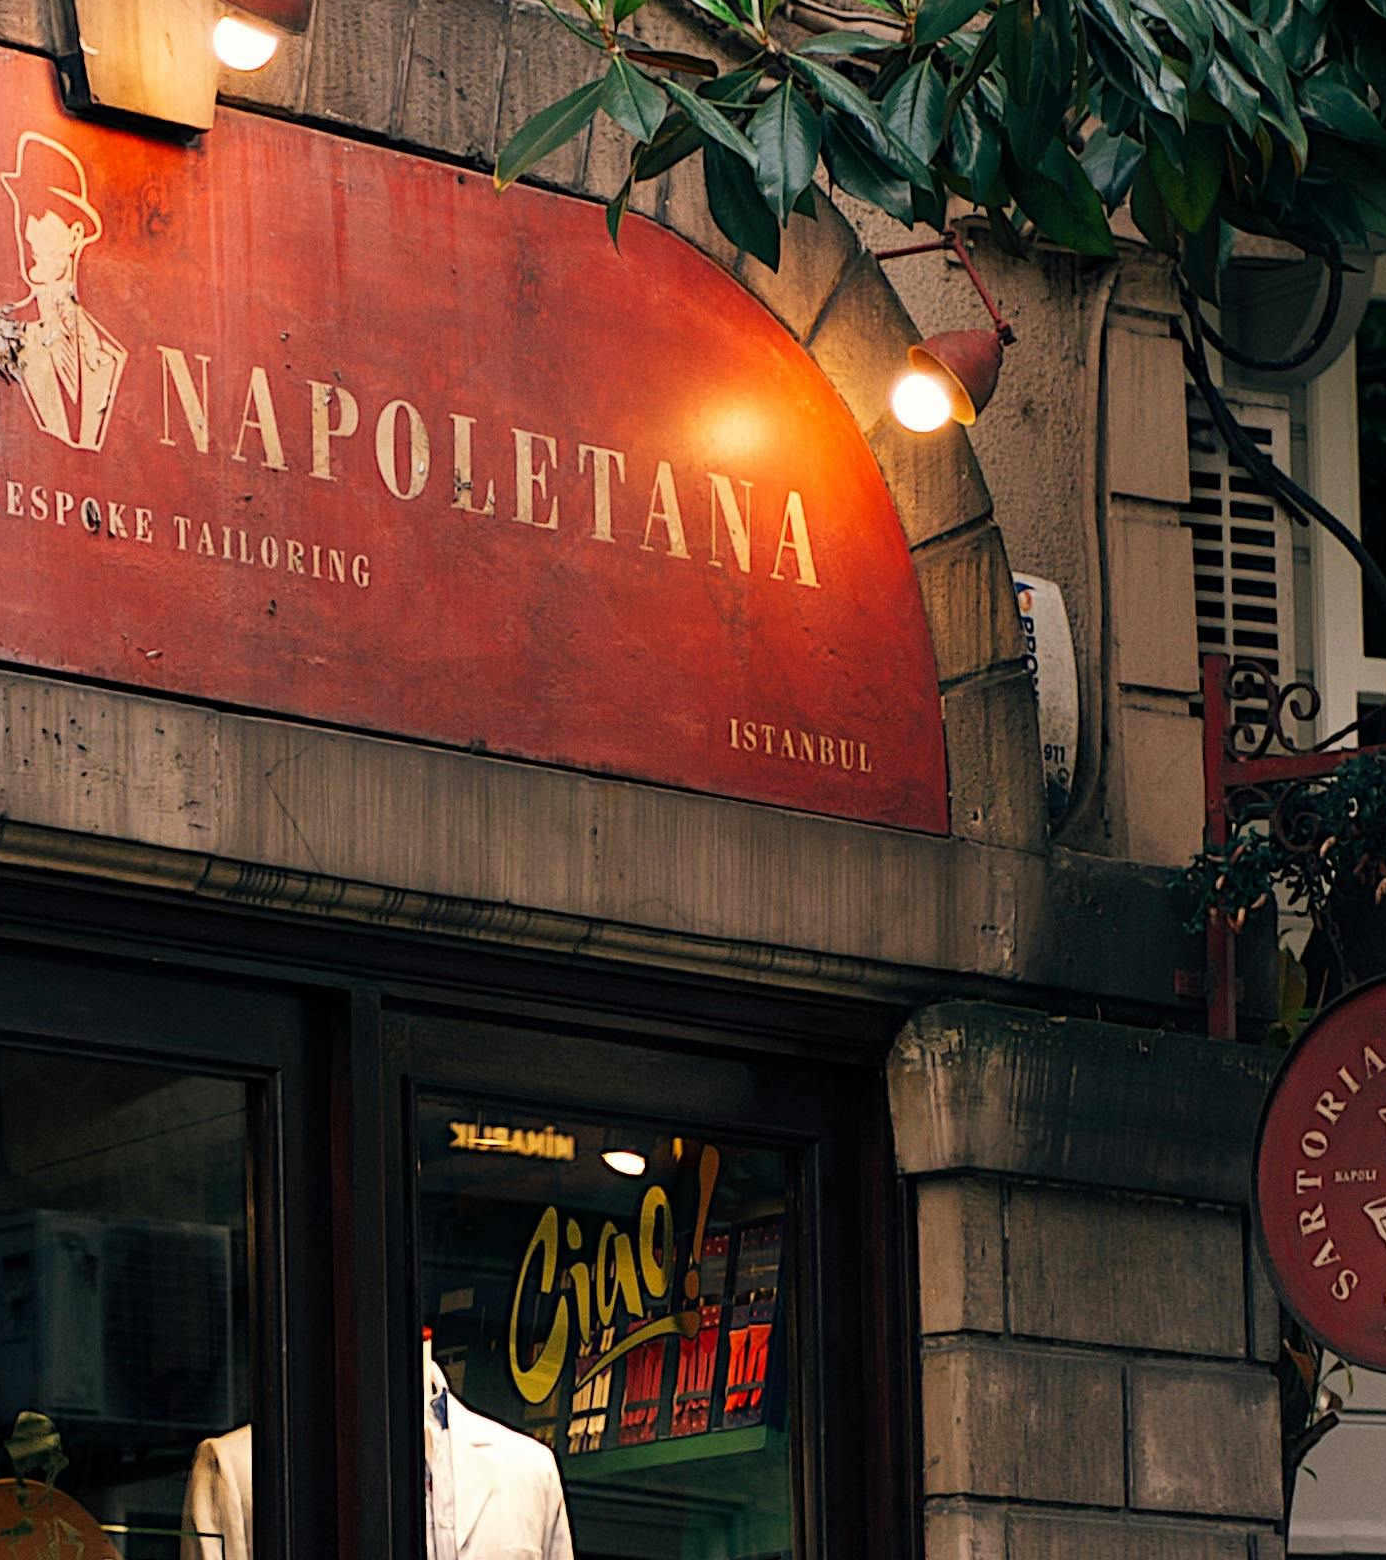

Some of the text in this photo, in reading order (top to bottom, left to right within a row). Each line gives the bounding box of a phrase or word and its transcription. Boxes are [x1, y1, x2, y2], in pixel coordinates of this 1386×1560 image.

[158, 343, 822, 590] NAPOLETANA
[173, 515, 373, 590] TAILORING
[727, 717, 873, 775] ISTANBUL
[1044, 744, 1065, 764] 911
[1334, 1169, 1377, 1183] NAPOLI
[509, 1144, 720, 1404] Ciao!
